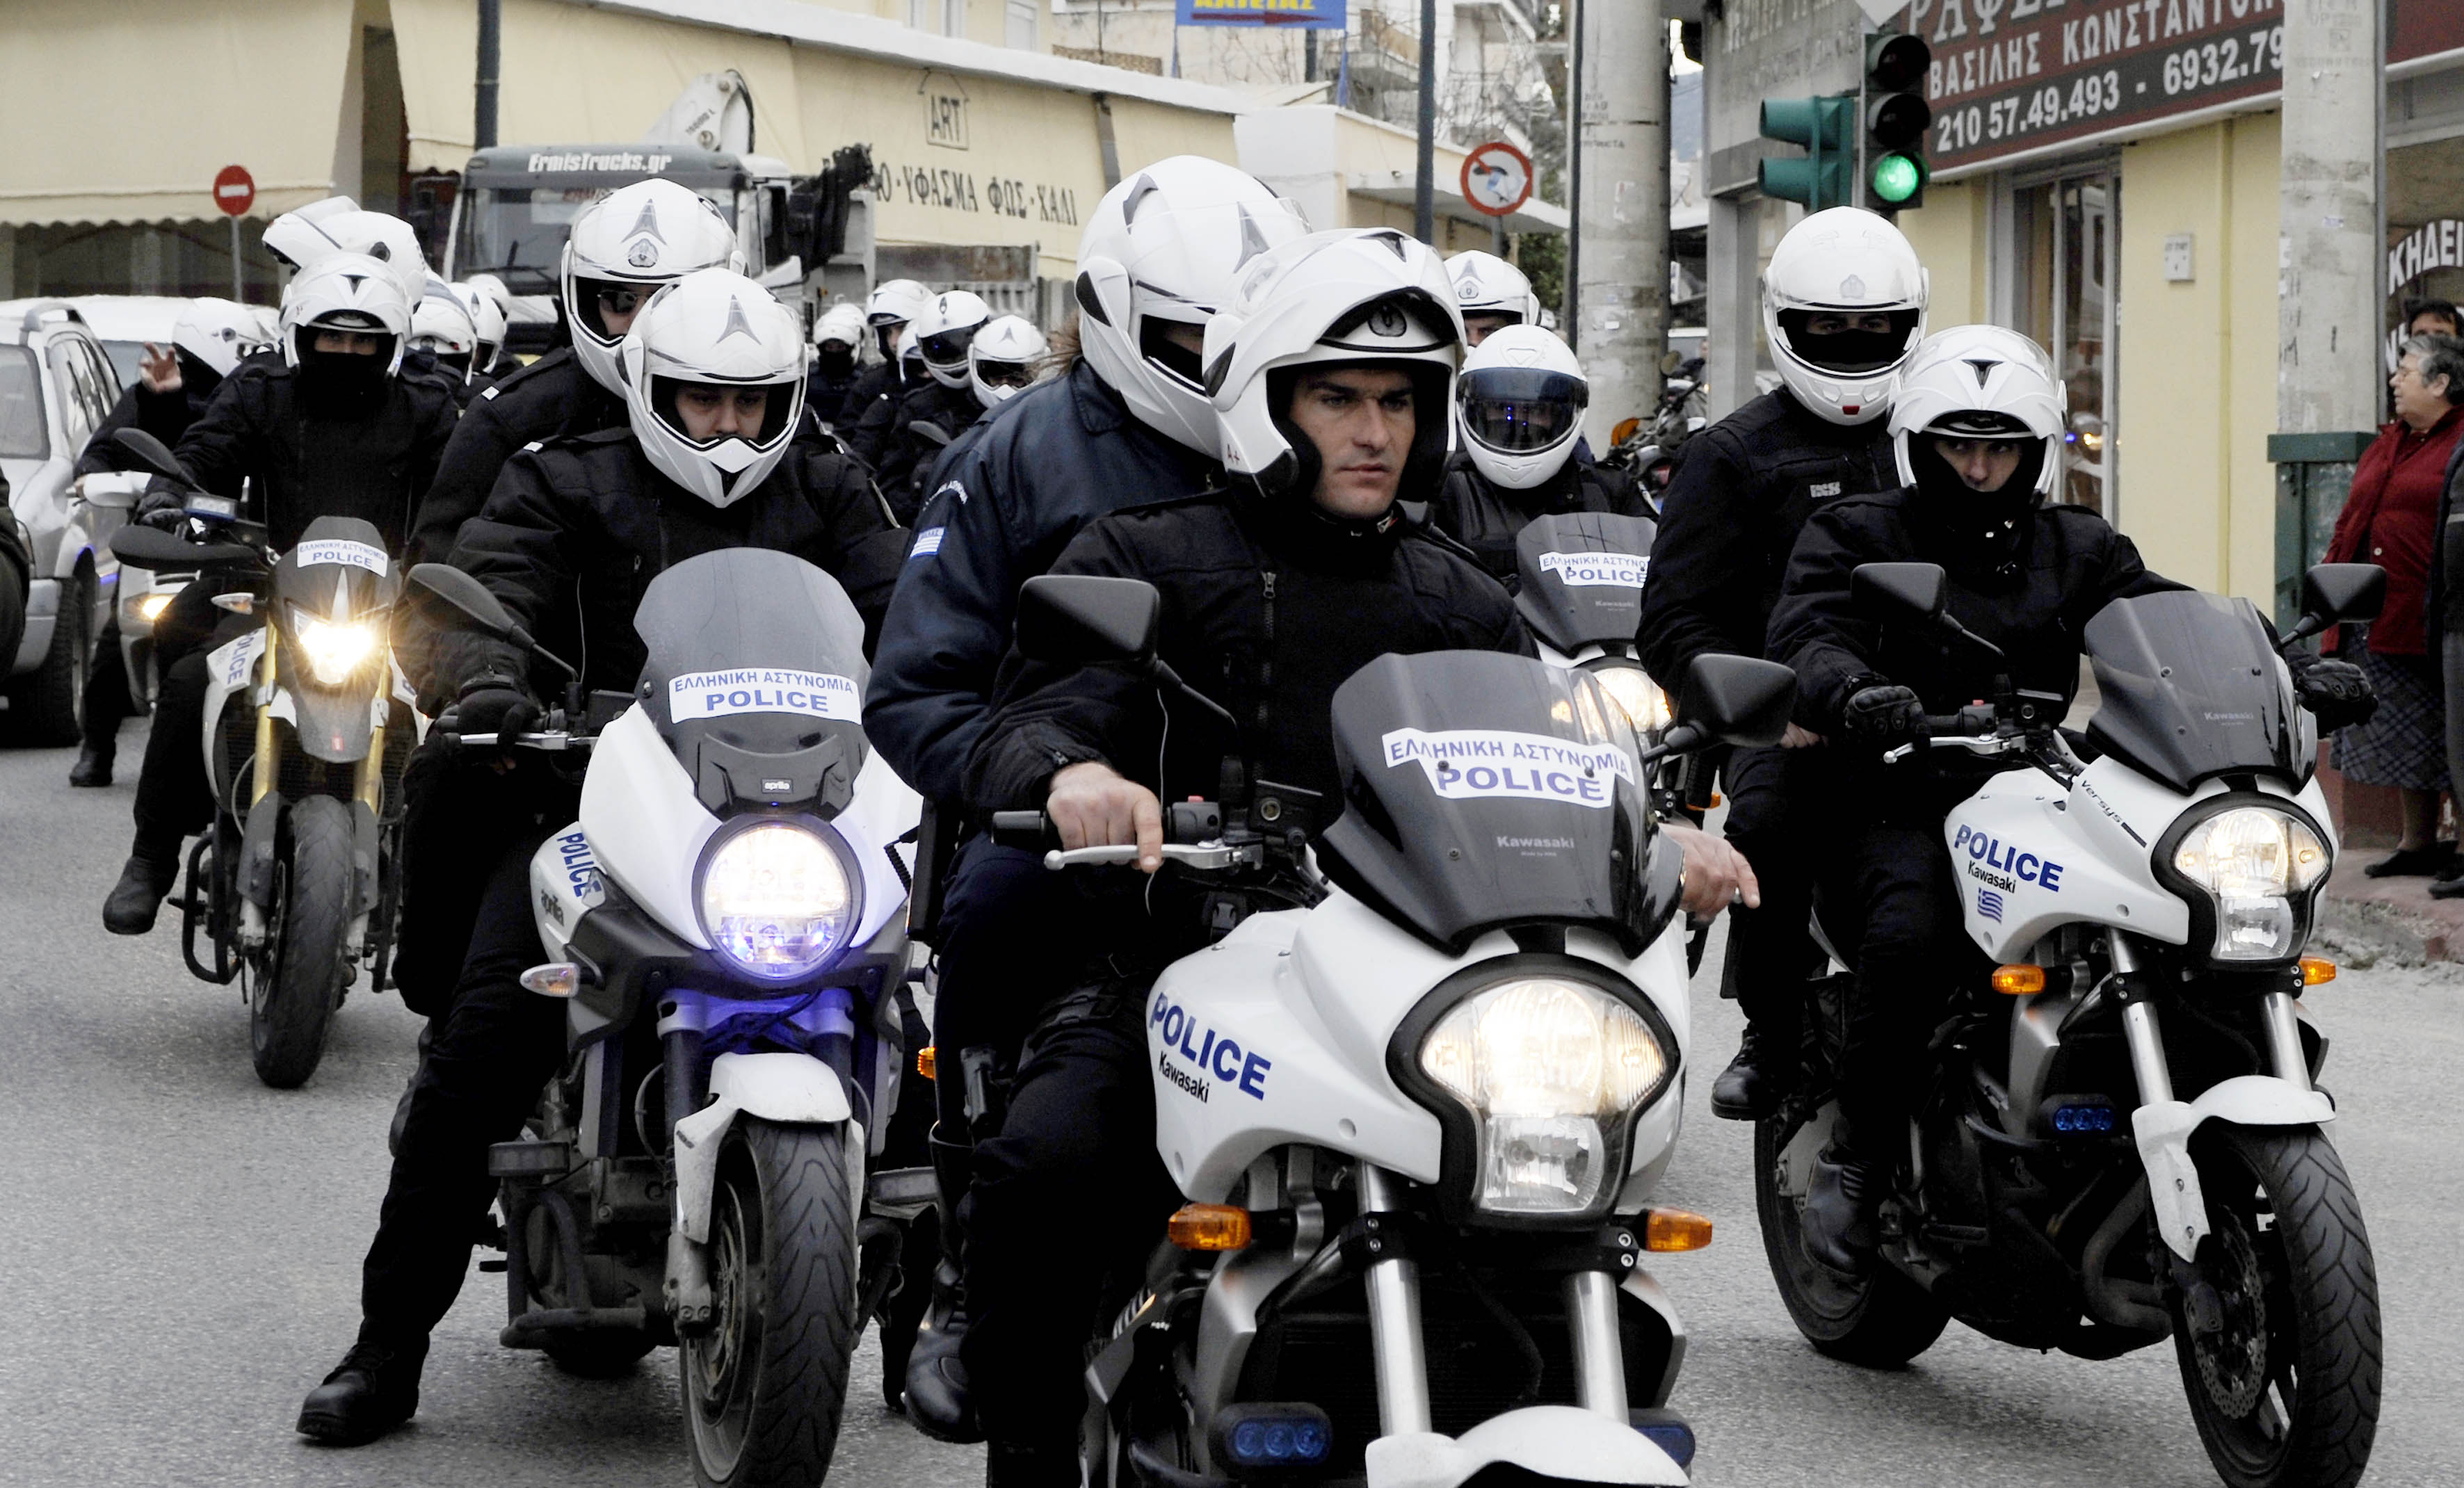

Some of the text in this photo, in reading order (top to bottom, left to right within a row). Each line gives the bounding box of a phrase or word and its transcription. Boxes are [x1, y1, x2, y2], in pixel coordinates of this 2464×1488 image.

[1928, 32, 2041, 101] ΒΑΣΙΛΗΣ
[1937, 106, 1981, 152] 210
[1988, 70, 2120, 139] 57.49.493
[2163, 26, 2284, 95] 6932.79
[931, 94, 960, 142] ART
[528, 152, 672, 174] ErmisTrucks.gr
[902, 165, 979, 213] ΥΦΑΣΜΑ
[987, 176, 1027, 219] ΦΩΣ
[1037, 184, 1078, 227] ΧΑΛΙ
[2388, 219, 2464, 296] ΚΗΔΕΙ
[300, 542, 385, 561] ΕΛΛΗΝΙΚΗ ΑΣΤΥΝΟΜΙΑ
[312, 551, 373, 568] POLICE
[1543, 556, 1599, 567] ΕΛΛΗΝΙΚΗ
[1565, 568, 1648, 583] POLICE
[675, 672, 853, 694] ΕΛΛΗΝΙΚΗ ΑΣΤΥΝΟΜΙΑ
[706, 690, 829, 712] POLICE
[2204, 711, 2254, 721] Kawasaki
[1390, 739, 1629, 777] ΕΛΛΗΝΙΚΗ ΑΣΤΥΝΟΜΙΑ
[1435, 766, 1604, 801] POLICE
[1497, 836, 1575, 848] Kawasaki
[1954, 824, 2064, 893] POLICE
[556, 832, 602, 898] POLICE
[1967, 859, 2017, 894] Kawasaki
[1149, 992, 1272, 1101] POLICE
[1159, 1050, 1210, 1104] Kawasaki
